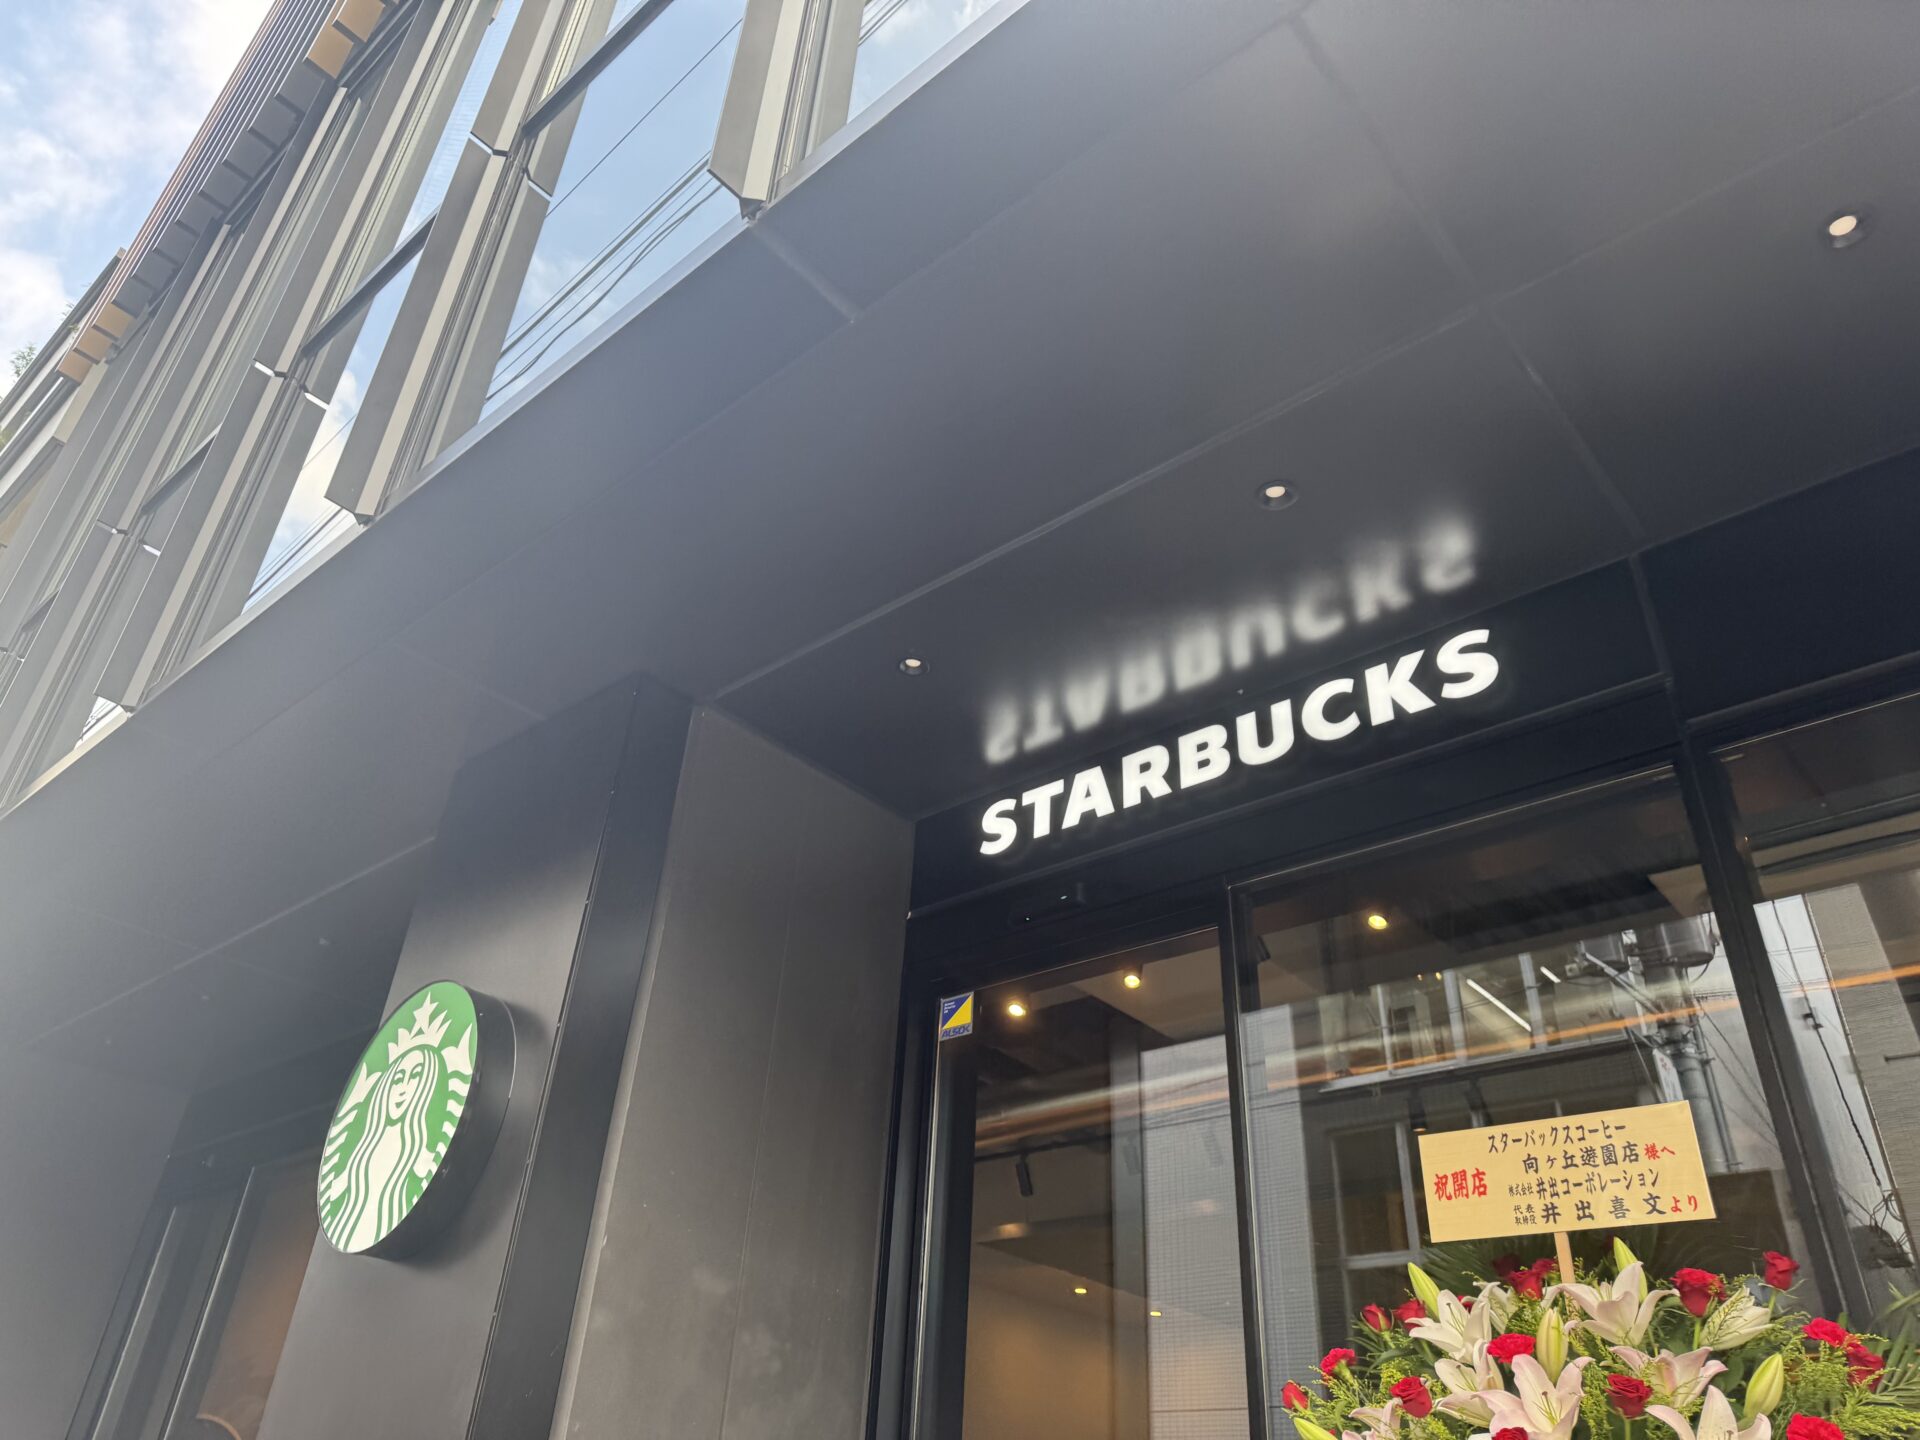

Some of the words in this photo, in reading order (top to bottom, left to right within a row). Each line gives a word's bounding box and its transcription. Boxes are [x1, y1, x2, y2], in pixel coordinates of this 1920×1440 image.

[980, 629, 1499, 855] STARBUCKS
[1488, 1119, 1627, 1154] スターバックスコーヒー
[1434, 1167, 1488, 1201] 祝開店
